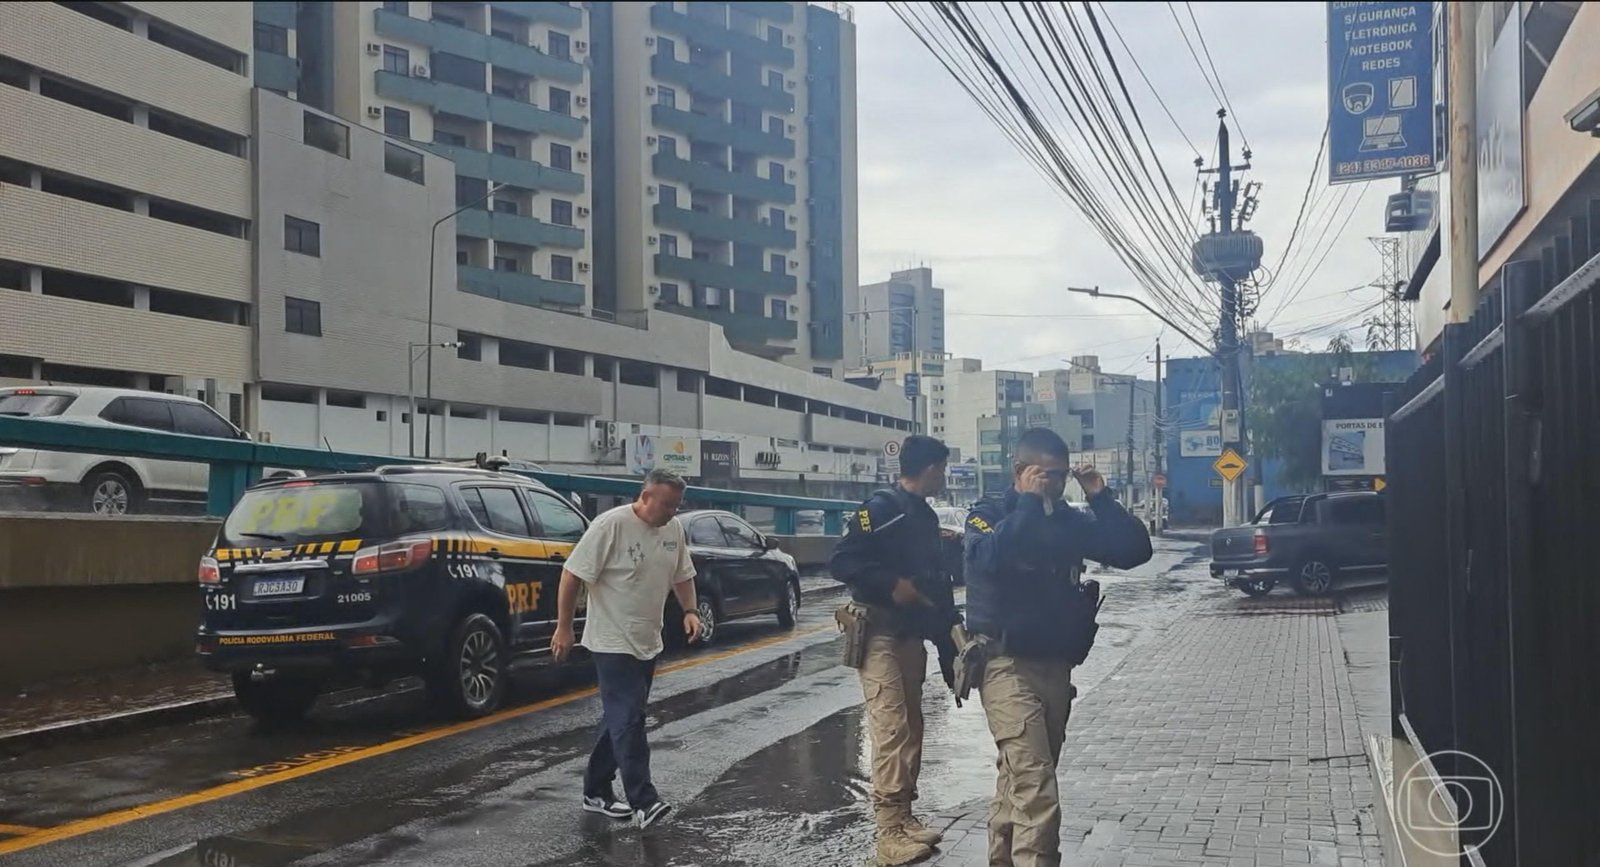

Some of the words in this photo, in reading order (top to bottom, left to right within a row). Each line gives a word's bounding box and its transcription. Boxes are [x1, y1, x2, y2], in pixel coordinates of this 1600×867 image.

[1350, 39, 1413, 56] NOTEBOOK
[1362, 57, 1401, 71] REDES
[1336, 162, 1361, 174] (24)
[1363, 154, 1430, 172] 3347-1036
[889, 443, 896, 453] E
[243, 493, 338, 532] PRF
[858, 510, 872, 533] PRF
[968, 516, 994, 533] PRF
[457, 563, 480, 579] 191
[213, 593, 236, 610] 191
[337, 592, 372, 604] 21005
[506, 581, 543, 616] PRF
[295, 632, 336, 642] FEDERAL
